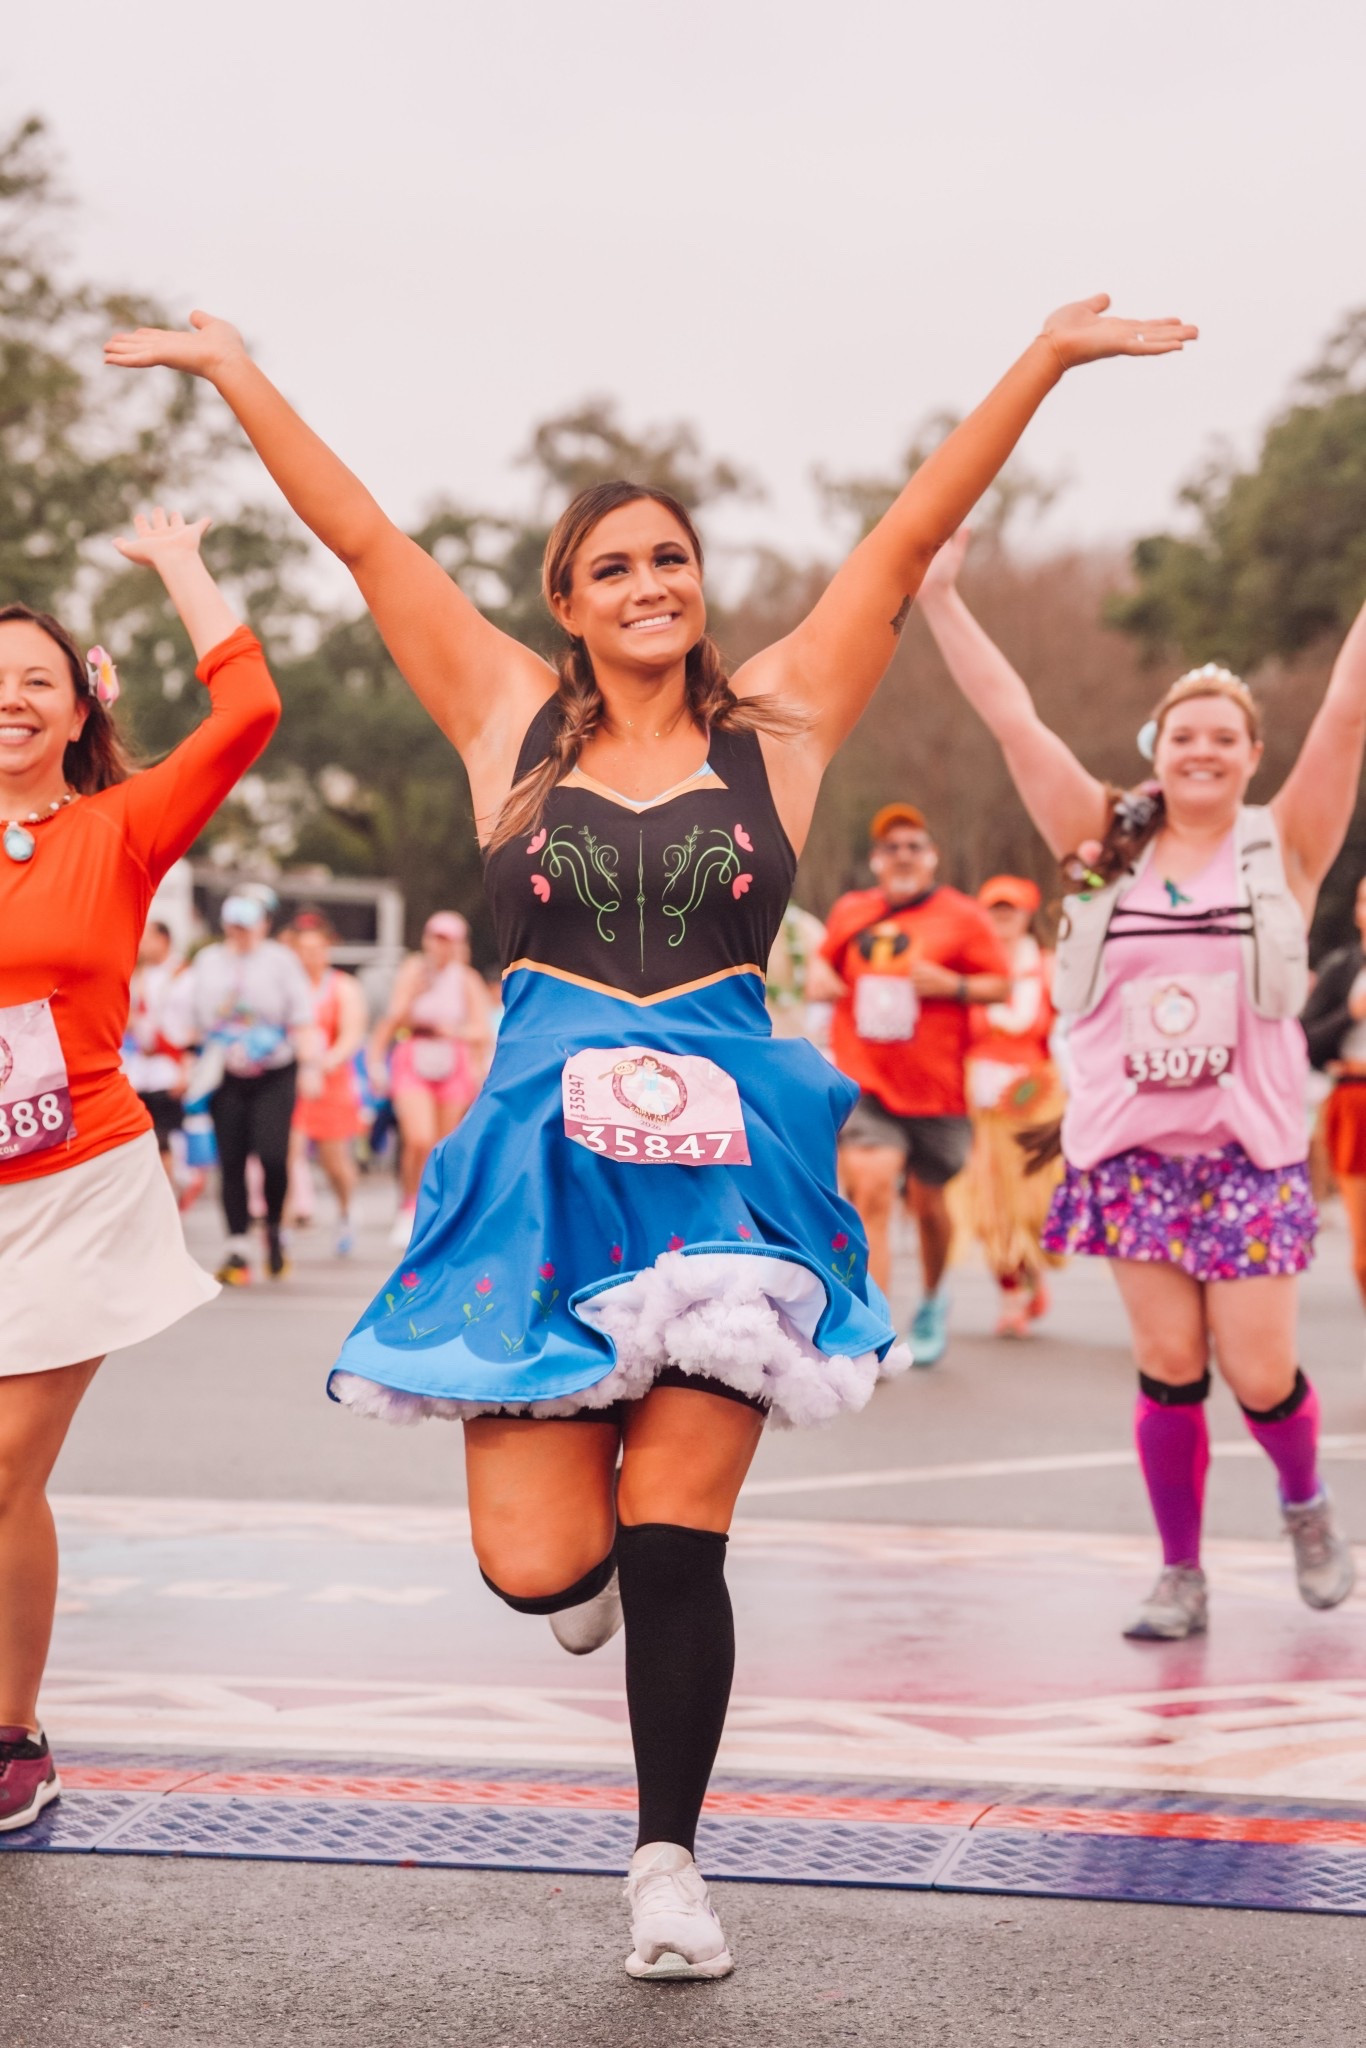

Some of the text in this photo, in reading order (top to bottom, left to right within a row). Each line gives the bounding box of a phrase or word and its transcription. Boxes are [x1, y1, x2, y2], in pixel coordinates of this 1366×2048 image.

[1129, 1046, 1230, 1083] 33079
[569, 1074, 585, 1111] 35847
[581, 1125, 733, 1159] 35847
